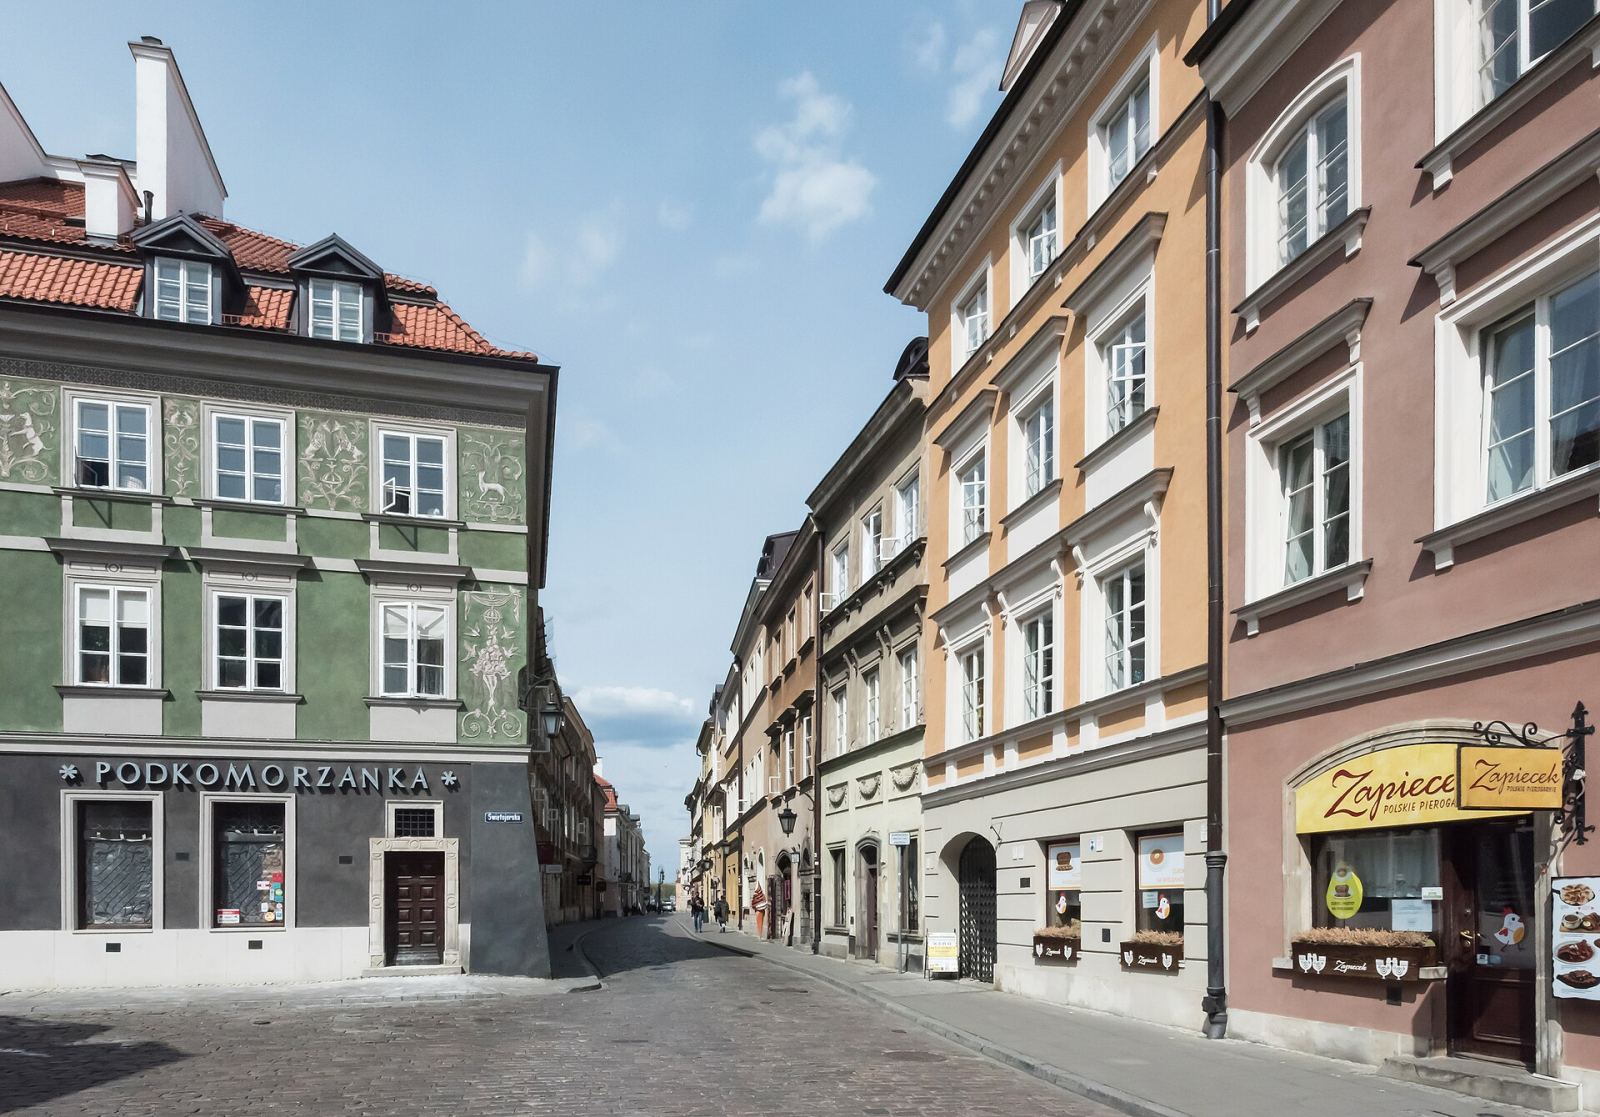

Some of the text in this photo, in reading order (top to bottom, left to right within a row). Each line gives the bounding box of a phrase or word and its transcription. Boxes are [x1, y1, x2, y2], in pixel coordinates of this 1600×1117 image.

[95, 761, 428, 790] PODKOMORZANKA
[1469, 758, 1560, 795] Zapiecek
[1323, 769, 1455, 821] Zapiece
[1383, 798, 1457, 814] POLSKIE PIEROGA
[1333, 960, 1368, 973] Zapiecek
